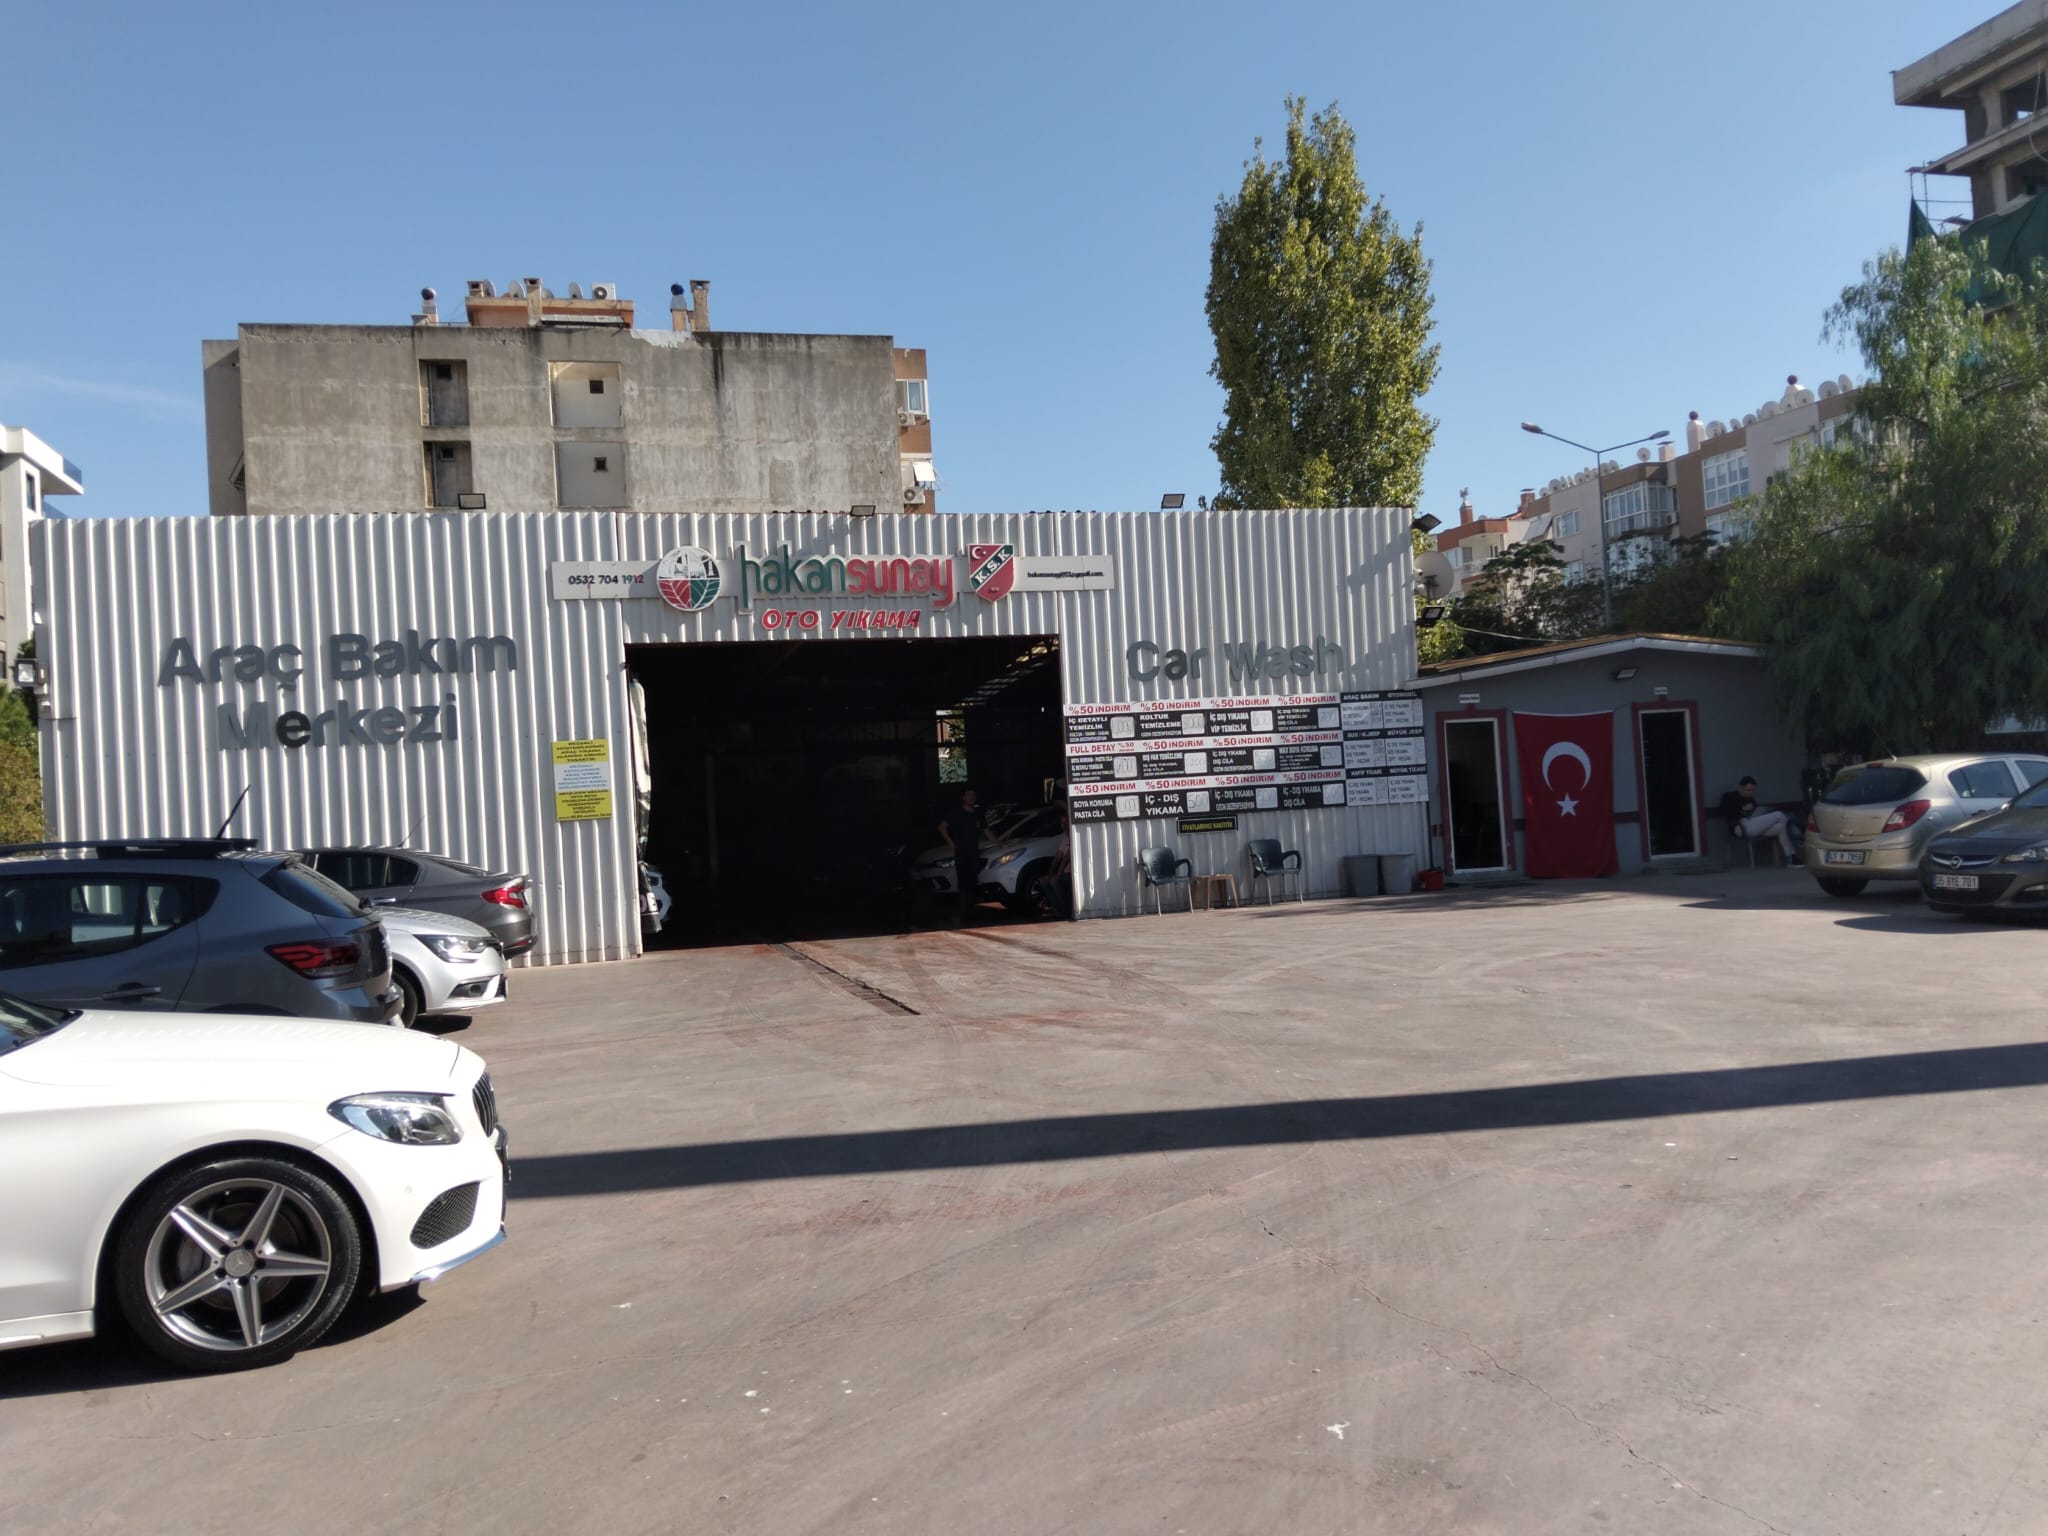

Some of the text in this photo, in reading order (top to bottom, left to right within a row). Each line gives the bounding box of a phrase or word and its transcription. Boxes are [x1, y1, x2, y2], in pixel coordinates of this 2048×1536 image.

[568, 574, 645, 585] 0532 704 1912
[761, 608, 922, 631] OTO YIKAMA
[158, 629, 518, 691] Araç Bakım
[1126, 634, 1345, 682] Car Wash
[217, 692, 459, 751] Merkezi
[1140, 721, 1181, 729] TEMİZLEME
[1070, 746, 1089, 754] FULL
[1091, 744, 1116, 753] DETAY
[1145, 794, 1155, 804] İÇ
[1163, 793, 1180, 804] DIŞ
[1145, 805, 1184, 816] YIKAMA
